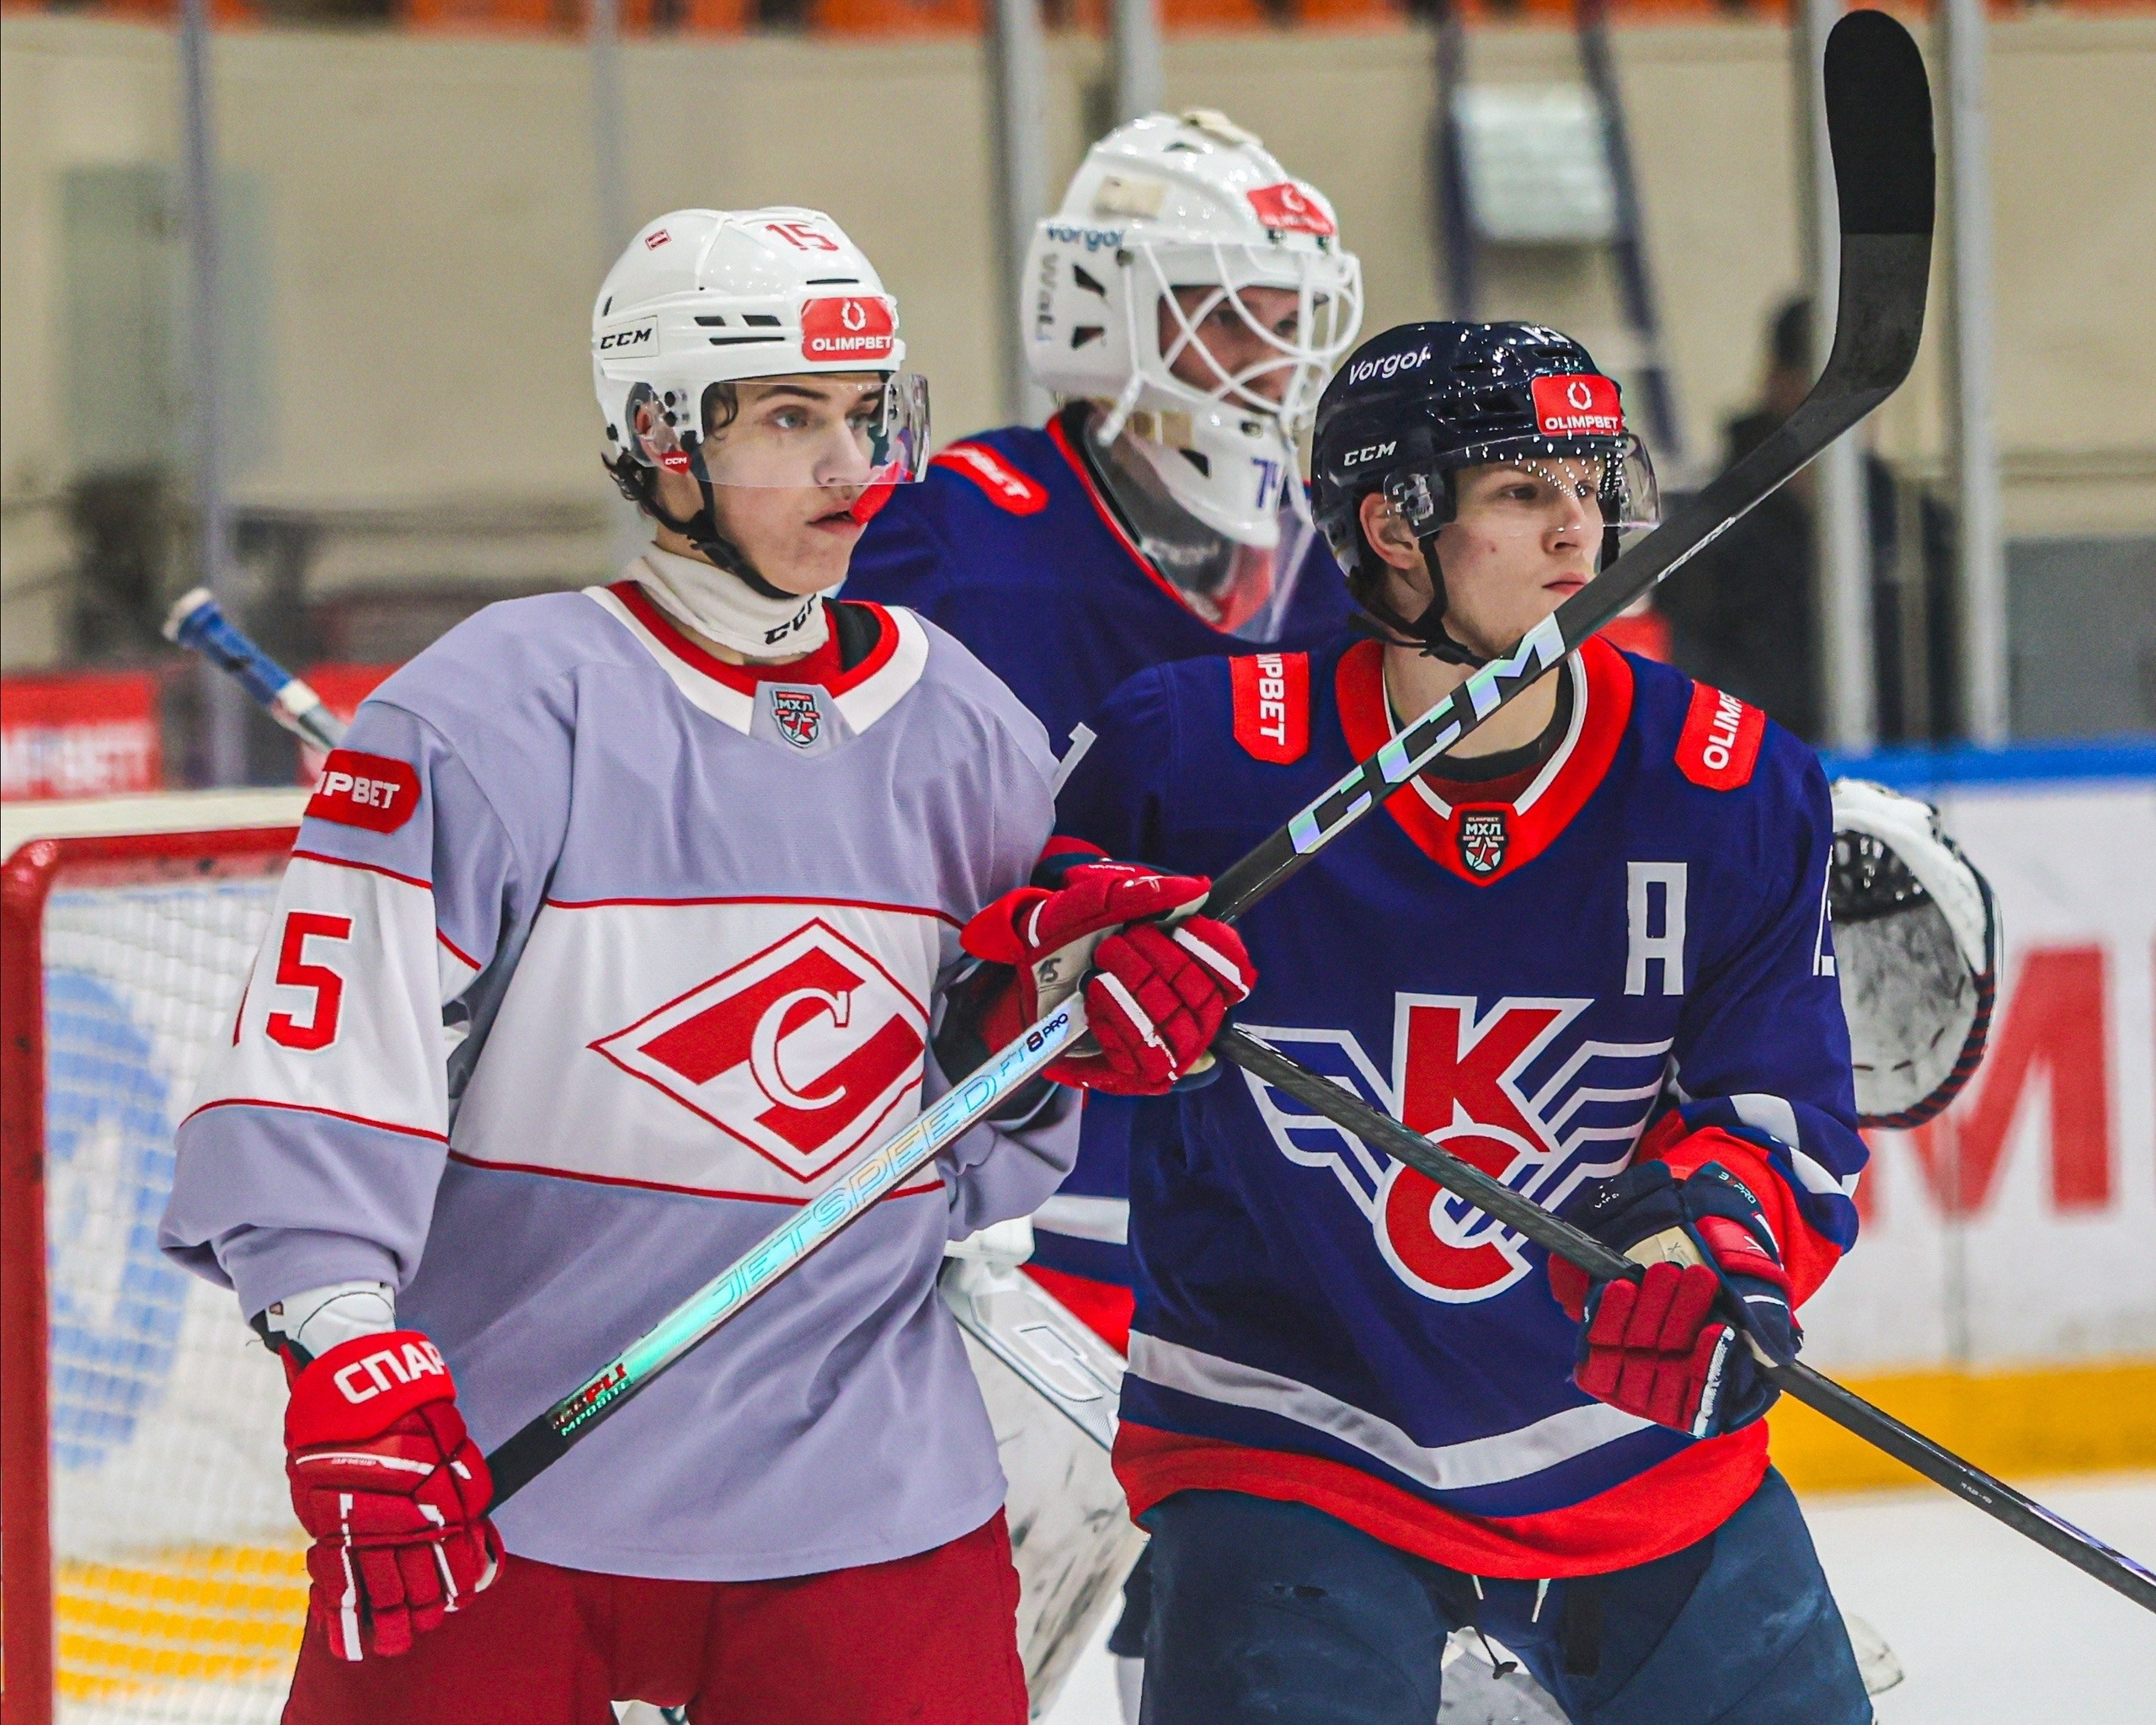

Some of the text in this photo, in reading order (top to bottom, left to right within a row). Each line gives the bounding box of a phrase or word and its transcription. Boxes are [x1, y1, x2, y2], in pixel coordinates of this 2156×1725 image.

[766, 223, 839, 251] 15
[600, 328, 654, 350] CCM
[811, 335, 893, 352] OLIMPBET
[1545, 414, 1619, 430] OLIMPBET
[664, 456, 688, 466] CCM
[1343, 441, 1397, 467] CCM
[1288, 612, 1566, 854] CCM
[1465, 822, 1502, 836] МХЛ
[1624, 861, 1688, 996] A
[232, 910, 353, 1052] 5
[711, 1074, 998, 1316] JETSPEED
[1042, 1012, 1070, 1039] PRO
